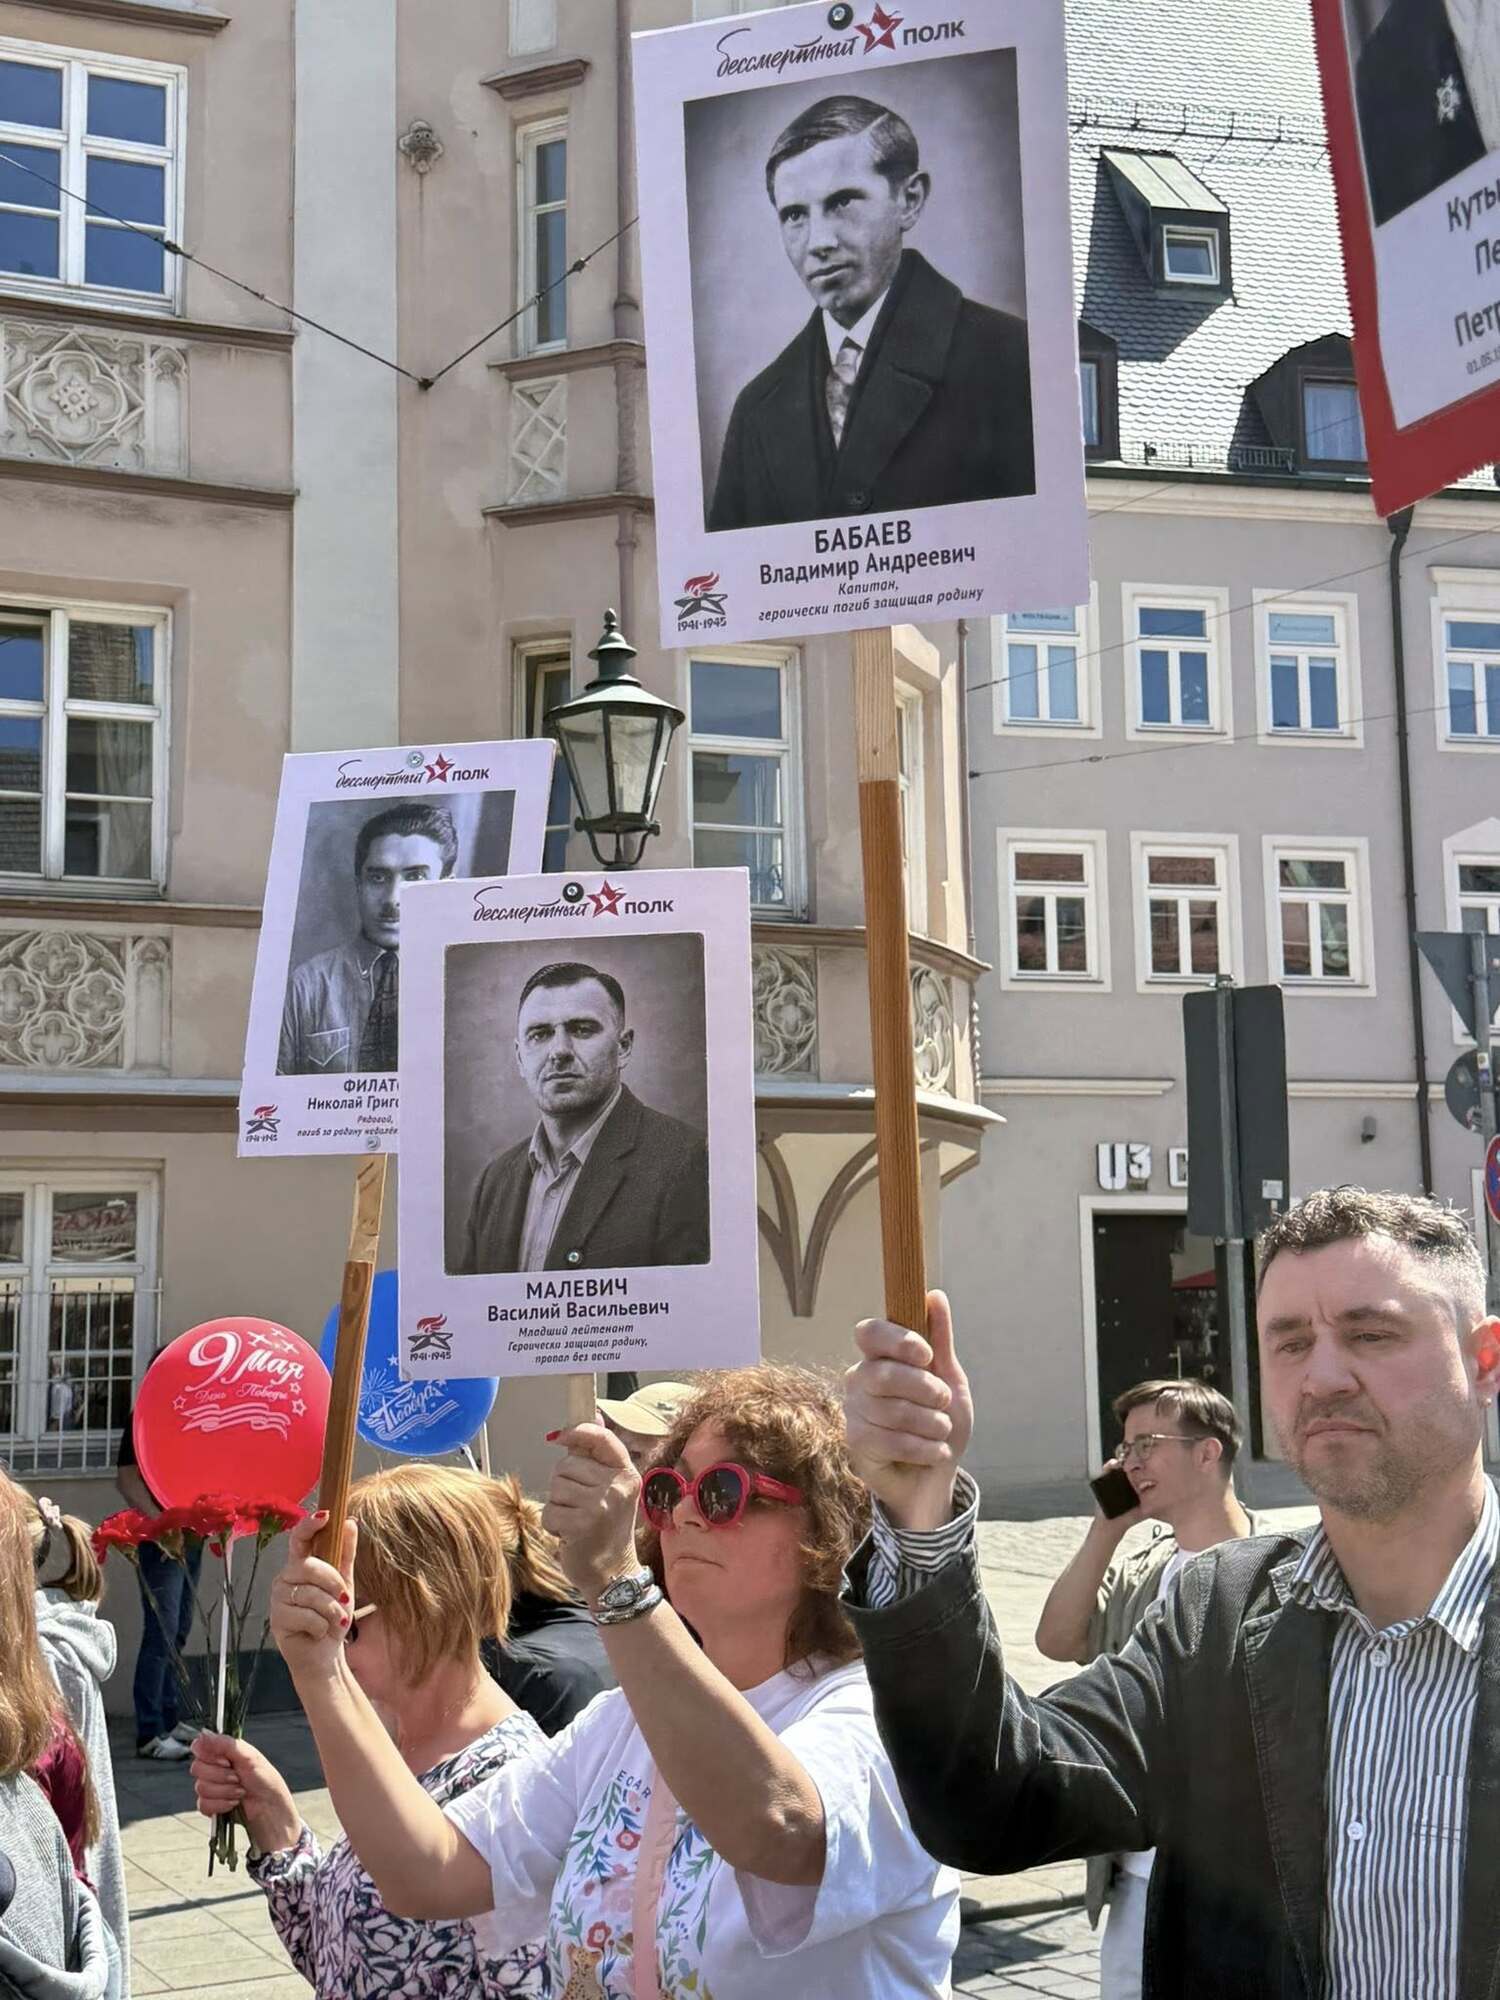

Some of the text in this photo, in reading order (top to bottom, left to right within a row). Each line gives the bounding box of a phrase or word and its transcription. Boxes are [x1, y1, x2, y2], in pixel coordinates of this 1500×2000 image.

[814, 519, 912, 553] БАБАЕВ
[760, 546, 976, 585] Владимир Андреевич
[838, 578, 899, 596] Капитан,
[758, 586, 984, 622] героически погиб защищая родину
[343, 1078, 399, 1093] ФИЛАТ
[307, 1096, 363, 1110] Николай
[1097, 1143, 1151, 1190] U3
[526, 1278, 628, 1300] МАЛЕВИЧ
[487, 1300, 669, 1322] Василий Васильевич
[518, 1323, 634, 1338] Младший лейтенант
[184, 1331, 305, 1392] 9 Мая
[572, 1351, 588, 1362] без
